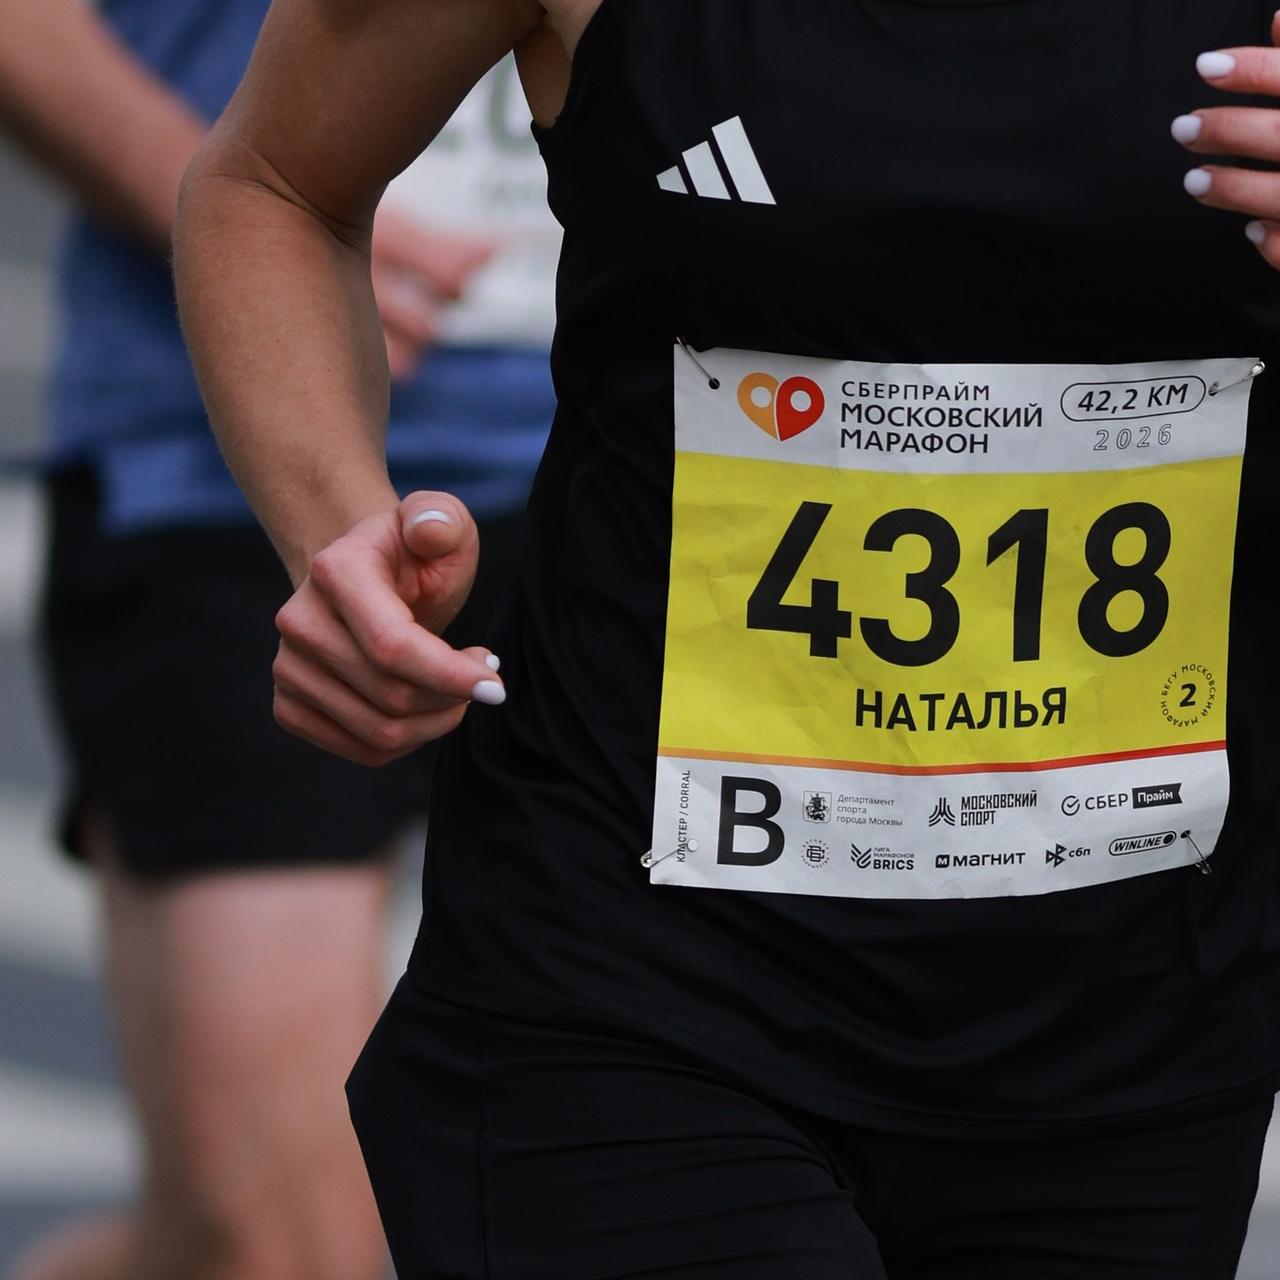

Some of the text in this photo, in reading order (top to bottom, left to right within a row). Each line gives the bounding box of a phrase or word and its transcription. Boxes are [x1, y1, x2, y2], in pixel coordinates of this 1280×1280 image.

[841, 380, 989, 401] СБЕРПРАЙМ
[1077, 388, 1139, 414] 42,2
[841, 403, 1043, 428] МОСКОВСКИЙ
[840, 429, 988, 454] МАРАФОН
[1093, 424, 1172, 451] 2026
[746, 501, 1171, 667] 4318
[1179, 683, 1197, 708] 2
[855, 687, 1067, 732] НАТАЛЬЯ
[680, 770, 691, 809] CORRAL
[837, 794, 895, 806] Департамент
[961, 790, 1037, 811] МОСКОВСКИЙ
[1085, 789, 1174, 811] СБЕР Прайм
[836, 816, 903, 826] города Москвы
[837, 805, 867, 814] спорта
[960, 810, 996, 827] СПОРТ
[676, 818, 688, 863] КЛАСТЕР
[1113, 836, 1162, 852] WINLINE
[873, 859, 914, 870] BRICS
